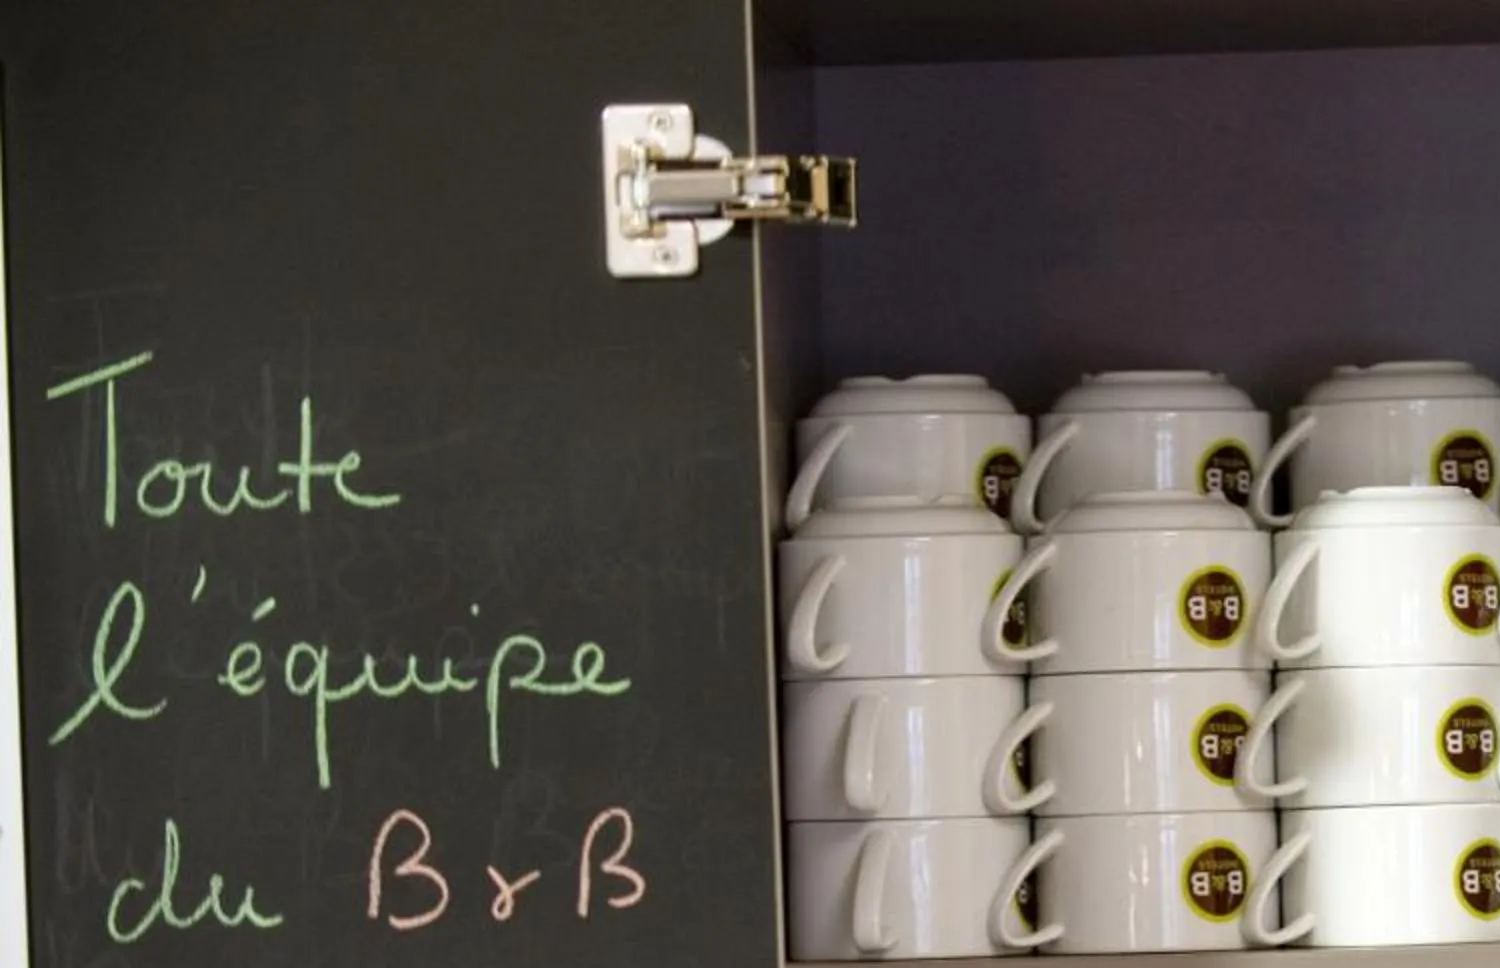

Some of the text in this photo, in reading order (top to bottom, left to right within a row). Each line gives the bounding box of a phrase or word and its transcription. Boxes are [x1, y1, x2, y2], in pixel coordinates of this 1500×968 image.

[47, 352, 401, 528] Toute
[49, 566, 631, 789] l'équipe
[1445, 729, 1494, 754] B&B
[107, 818, 283, 943] du
[367, 809, 450, 930] B
[577, 807, 646, 918] B
[1191, 870, 1242, 896] B&B
